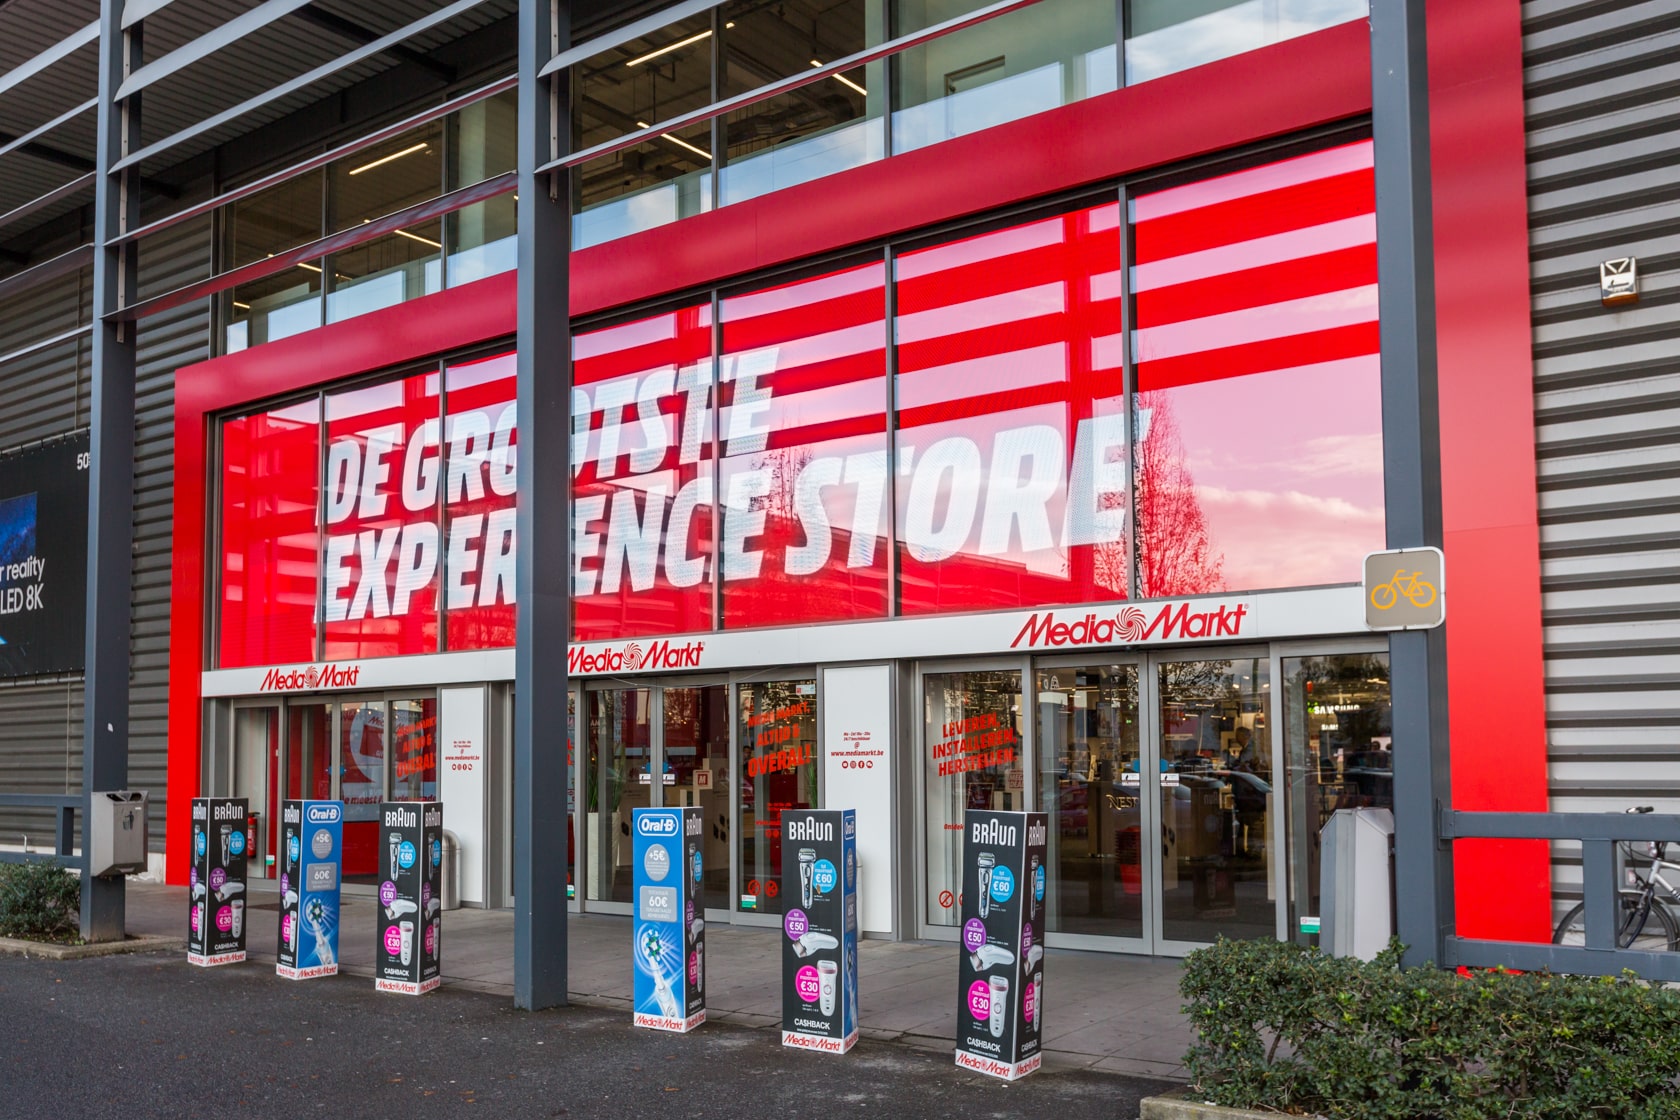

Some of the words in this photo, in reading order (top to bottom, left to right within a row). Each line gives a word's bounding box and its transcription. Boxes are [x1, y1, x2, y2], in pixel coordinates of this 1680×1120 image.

[315, 424, 396, 526] DE
[314, 467, 774, 624] EXPERENCE
[784, 409, 1153, 576] STORE
[6, 555, 46, 582] reality
[25, 583, 44, 611] 8K
[756, 725, 791, 747] ALTIJD
[932, 727, 1018, 759] INSTALLEREN,
[748, 743, 811, 777] OVERAL!
[831, 749, 884, 757] www.mediamarkt.be
[938, 747, 1018, 777] HERSTELLEN.
[214, 802, 243, 820] BRAUN
[385, 807, 416, 828] BRAUN
[788, 816, 833, 841] BRAUN
[972, 818, 1016, 846] BRAUN
[1028, 819, 1046, 846] BRAUN
[649, 850, 665, 861] +5€
[314, 870, 330, 880] 60€
[815, 873, 832, 883] €60
[993, 881, 1009, 892] €60
[383, 891, 394, 899] €50
[649, 896, 668, 907] 60€
[789, 922, 804, 931] €50
[387, 938, 400, 947] €30
[967, 932, 982, 942] €50
[384, 967, 410, 977] CASHBACK
[800, 981, 818, 992] €30
[972, 997, 988, 1010] €30
[794, 1017, 831, 1030] CASHBACK
[967, 1036, 1001, 1052] CASHBACK
